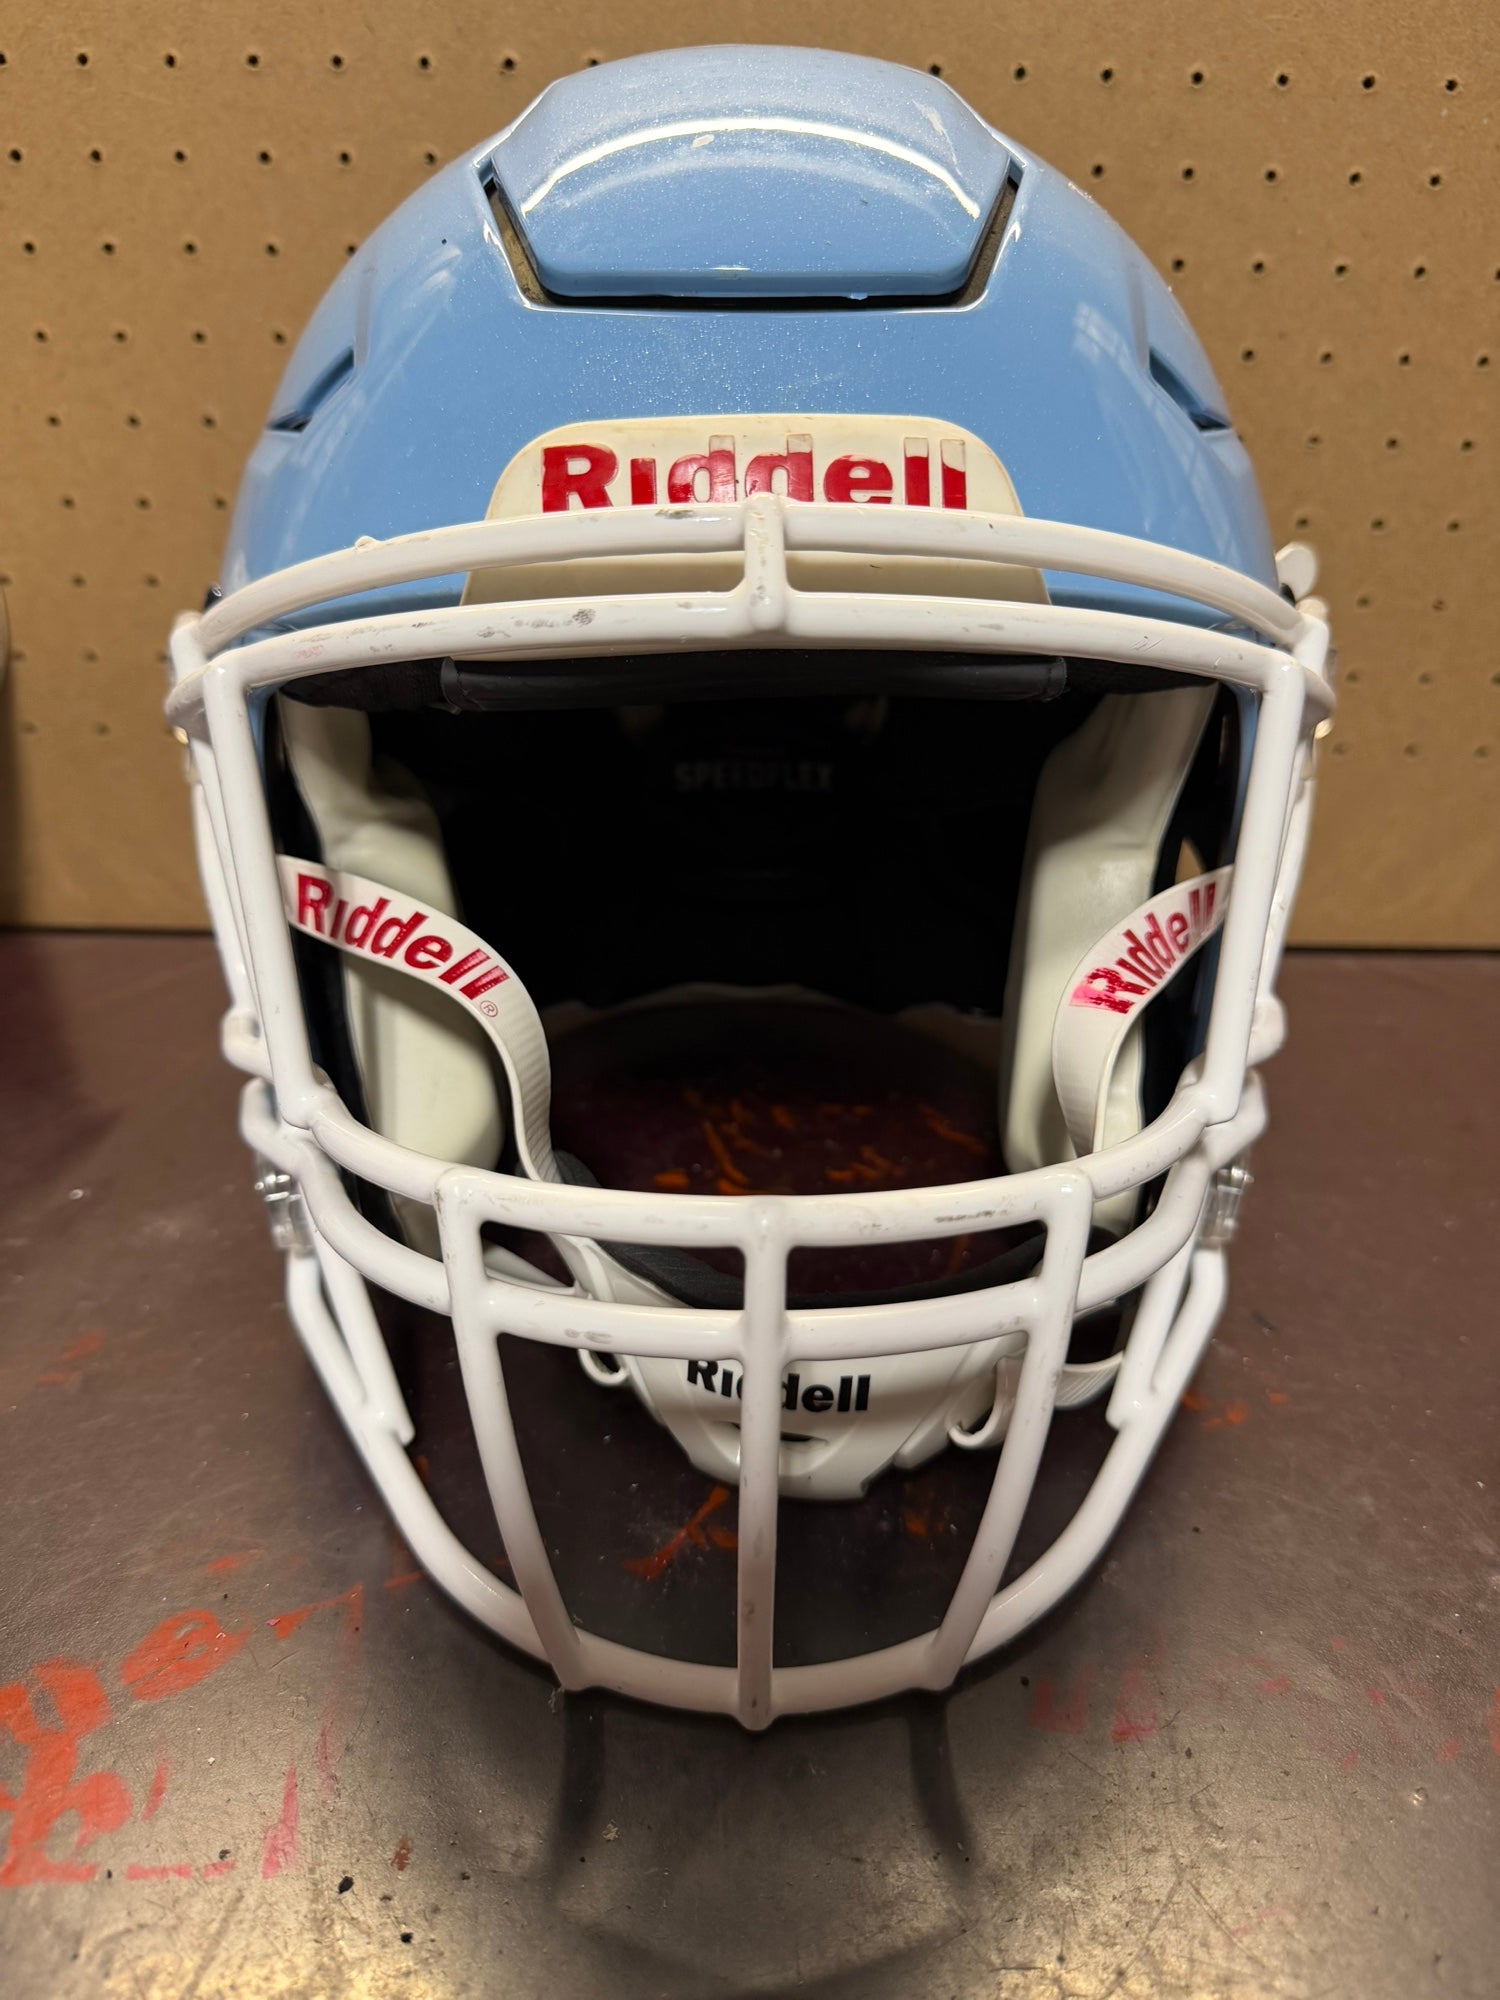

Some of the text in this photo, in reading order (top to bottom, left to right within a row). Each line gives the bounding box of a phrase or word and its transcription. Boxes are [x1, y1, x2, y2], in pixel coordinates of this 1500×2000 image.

[541, 434, 967, 512] Riddell
[1069, 881, 1217, 1015] Riddell
[686, 1359, 871, 1412] Ridell
